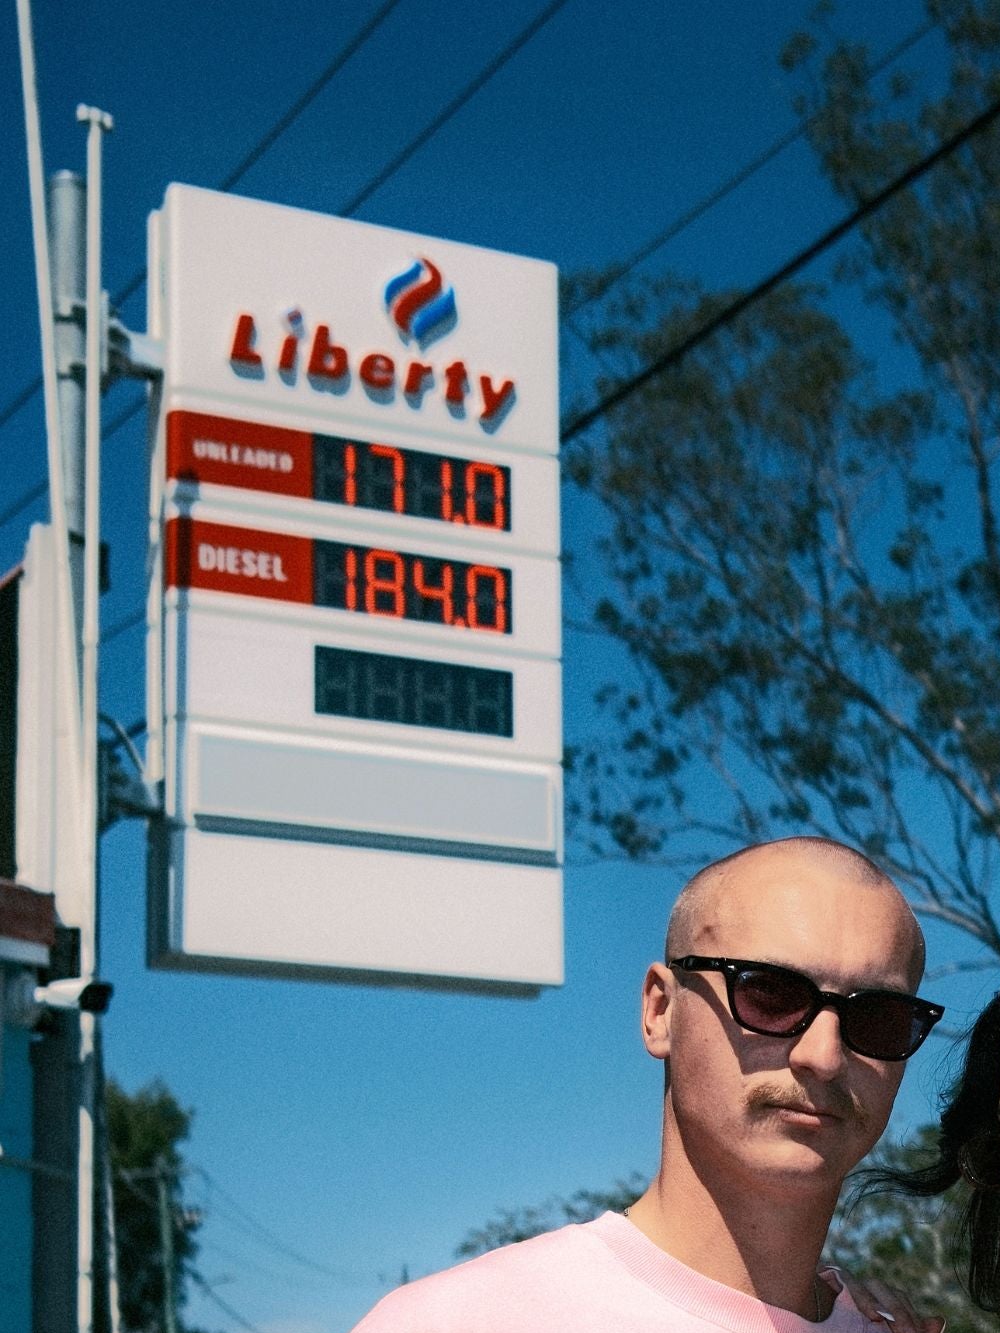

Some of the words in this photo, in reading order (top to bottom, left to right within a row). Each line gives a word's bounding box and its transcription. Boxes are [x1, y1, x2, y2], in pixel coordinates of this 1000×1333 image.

[231, 308, 515, 421] Liberty
[193, 439, 294, 474] UNLEADED
[344, 443, 506, 531] 171.0
[197, 543, 289, 582] DIESEL
[344, 548, 507, 634] 184.0
